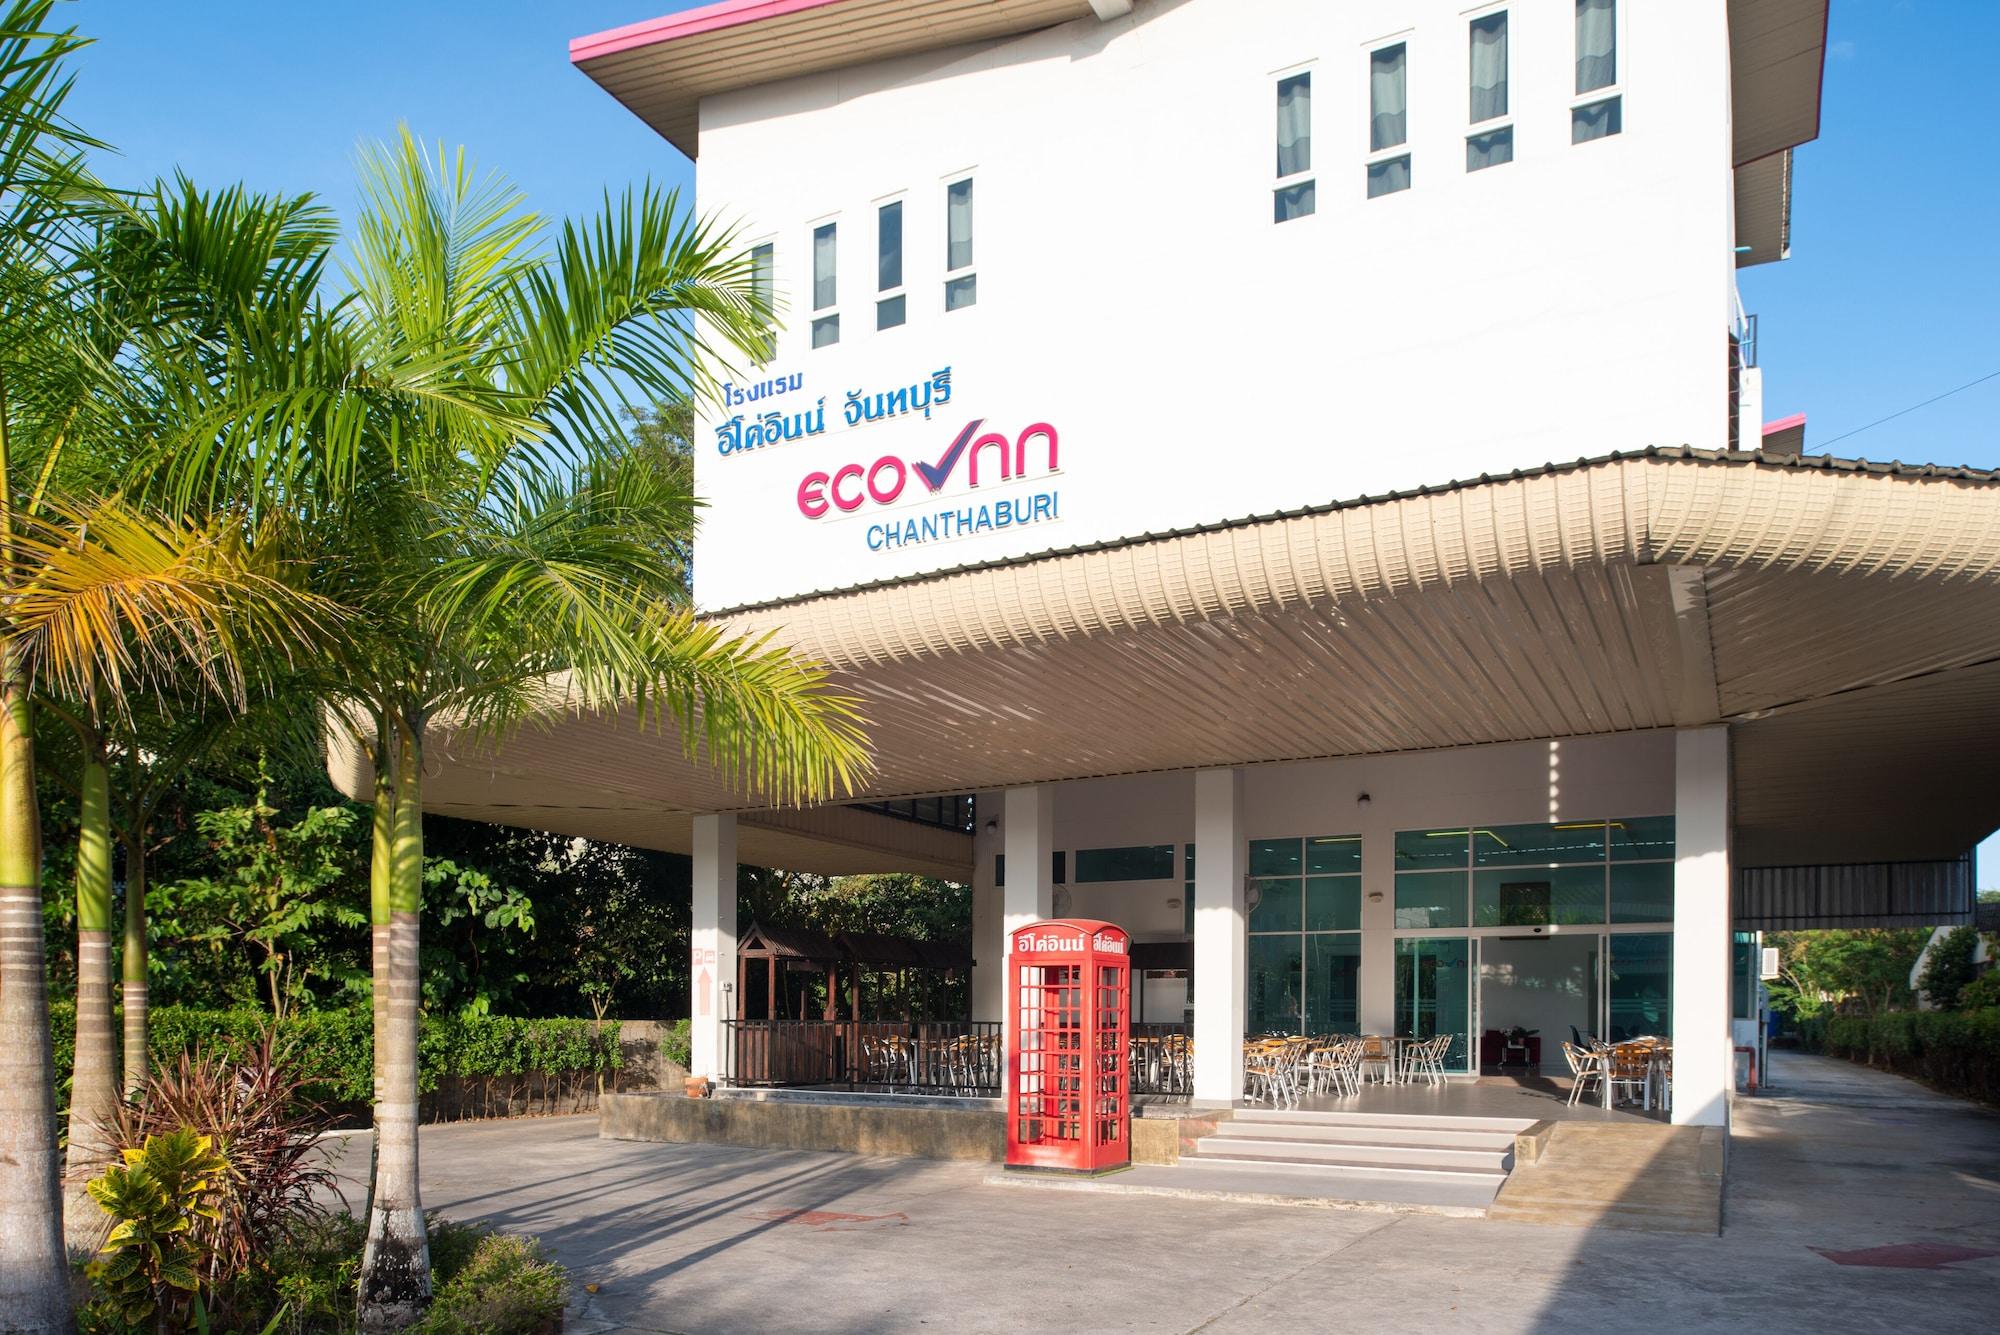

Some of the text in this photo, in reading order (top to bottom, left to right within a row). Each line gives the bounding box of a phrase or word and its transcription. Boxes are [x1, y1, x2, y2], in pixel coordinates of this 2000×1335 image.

[723, 372, 803, 407] โรงแรม
[844, 366, 952, 420] จันทบุรี
[866, 491, 1059, 551] CHANTHABURI
